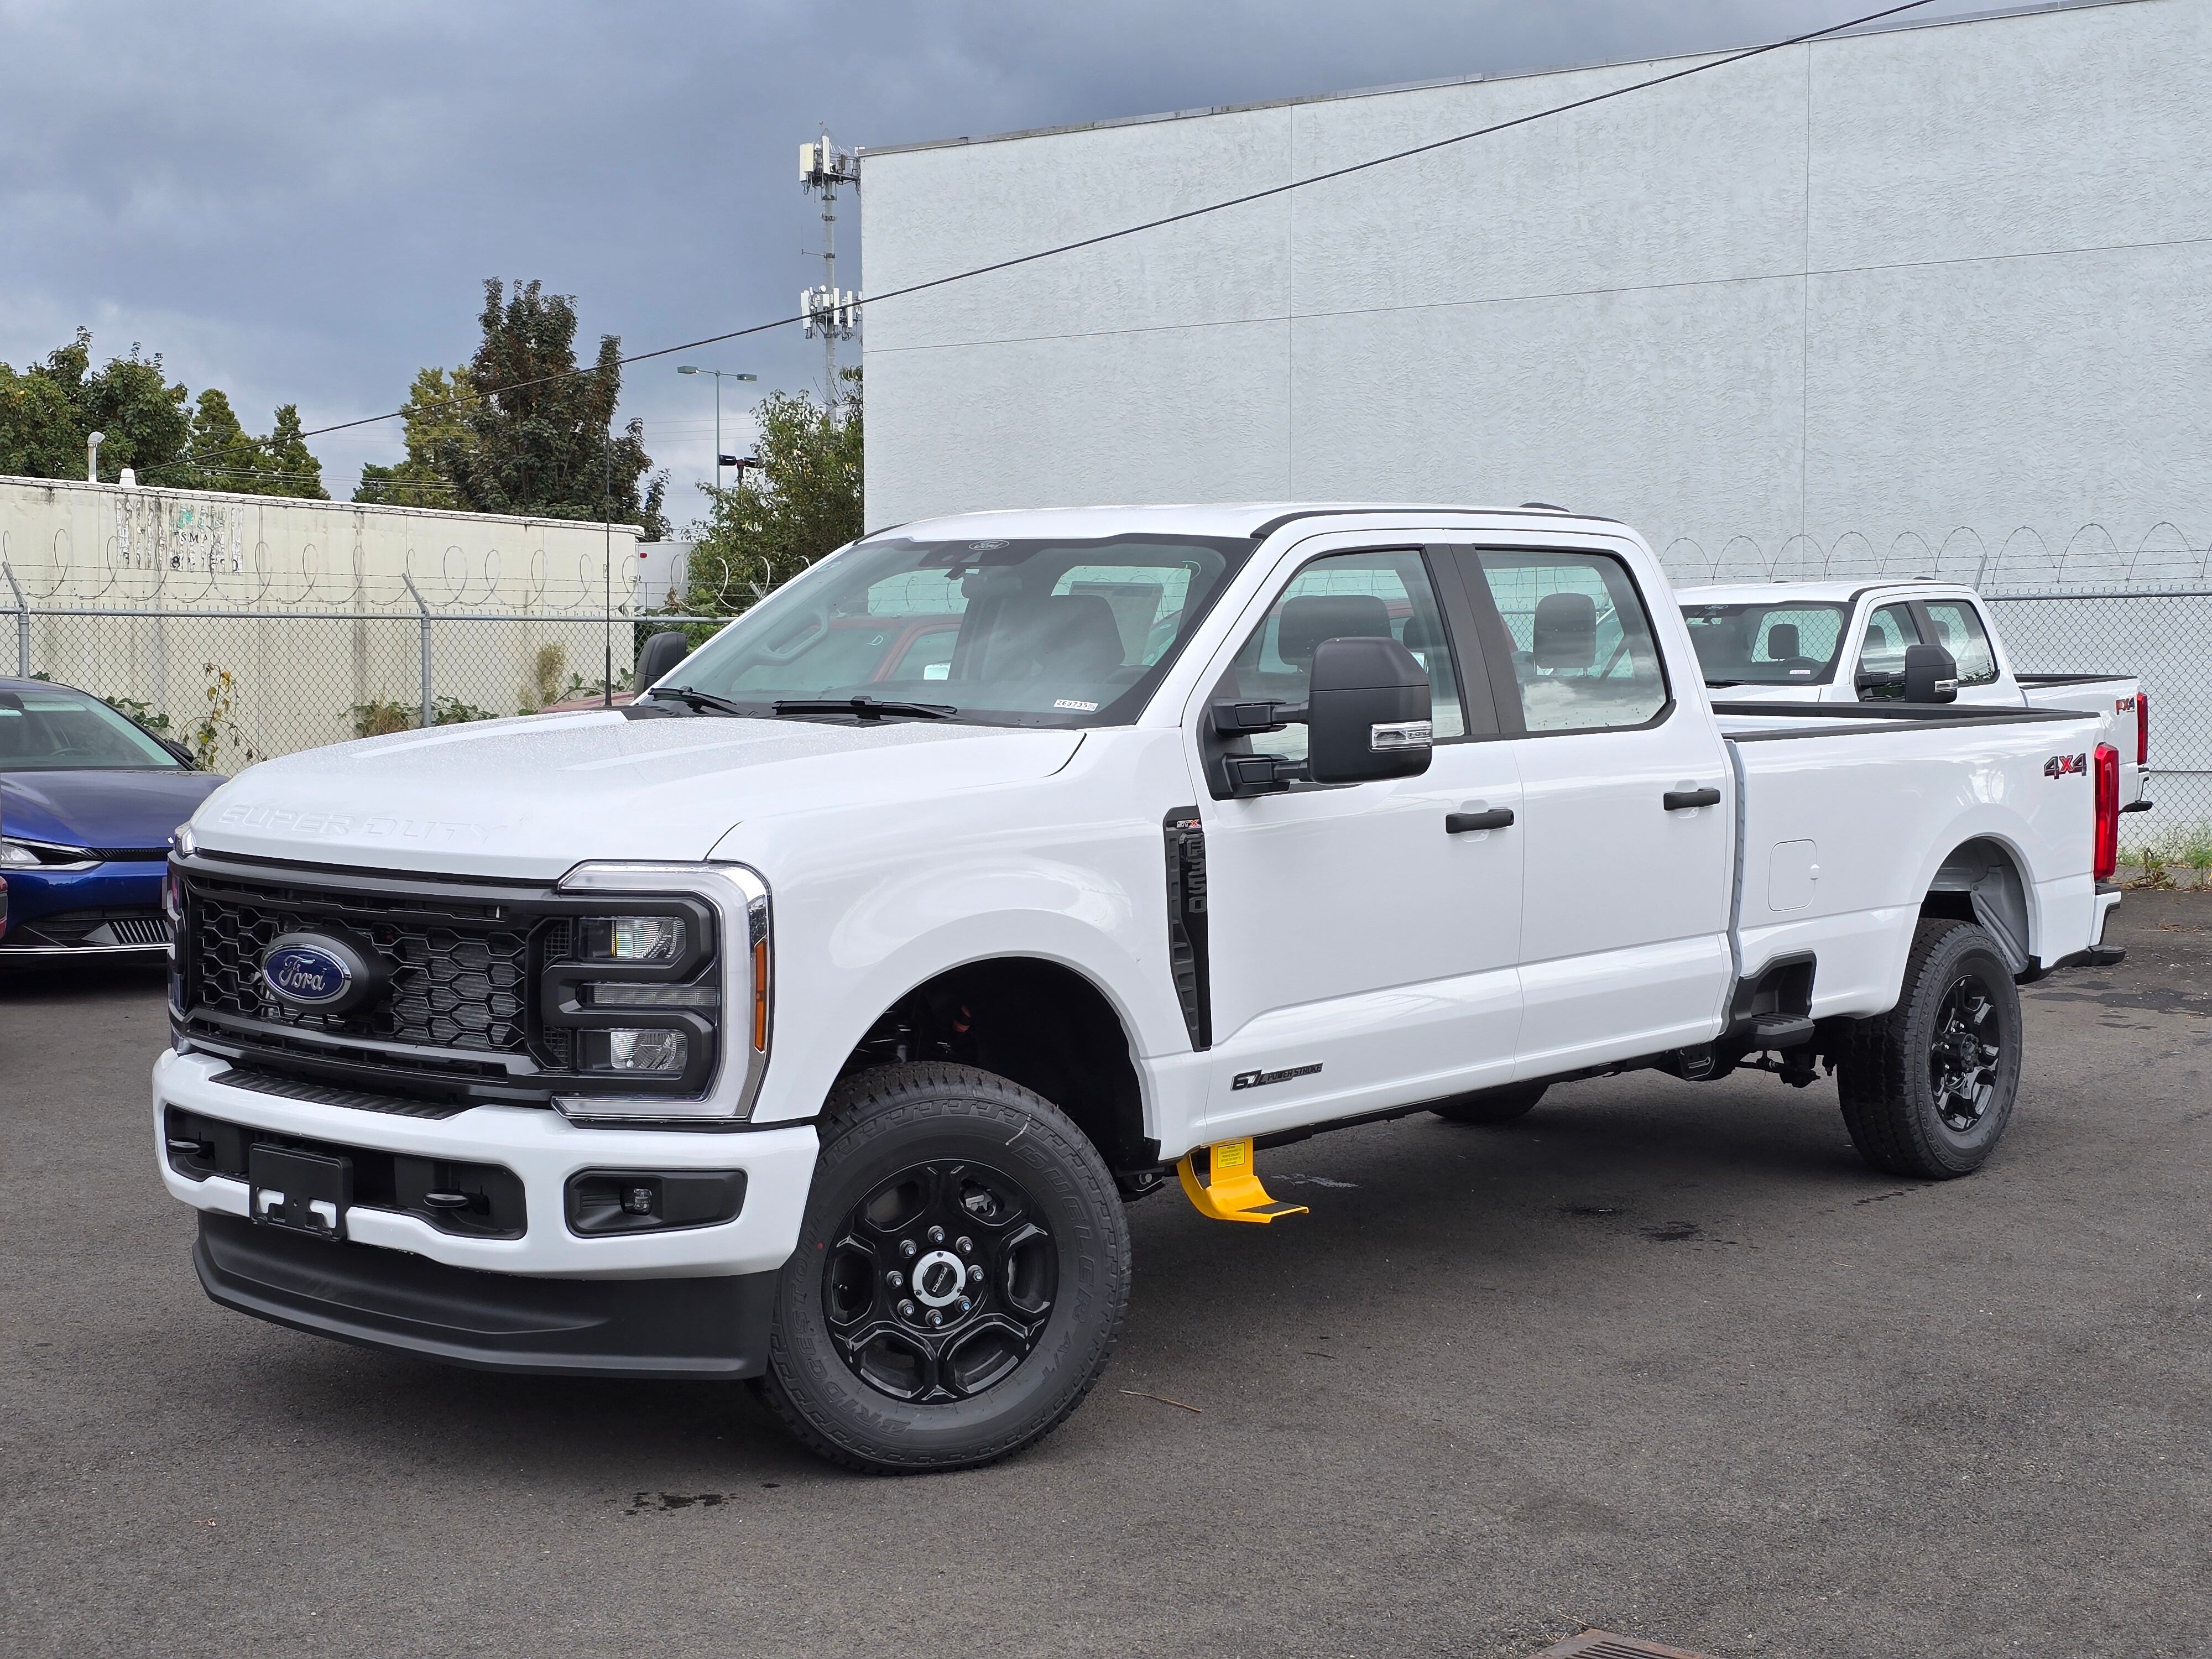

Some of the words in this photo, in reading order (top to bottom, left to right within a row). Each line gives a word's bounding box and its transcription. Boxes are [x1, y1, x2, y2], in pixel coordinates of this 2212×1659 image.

[218, 804, 357, 836] SUPER
[366, 816, 508, 843] DUTY
[1177, 819, 1201, 828] STX
[279, 954, 327, 991] Ford
[1011, 1142, 1097, 1324] DUELER
[932, 1266, 948, 1292] FORD
